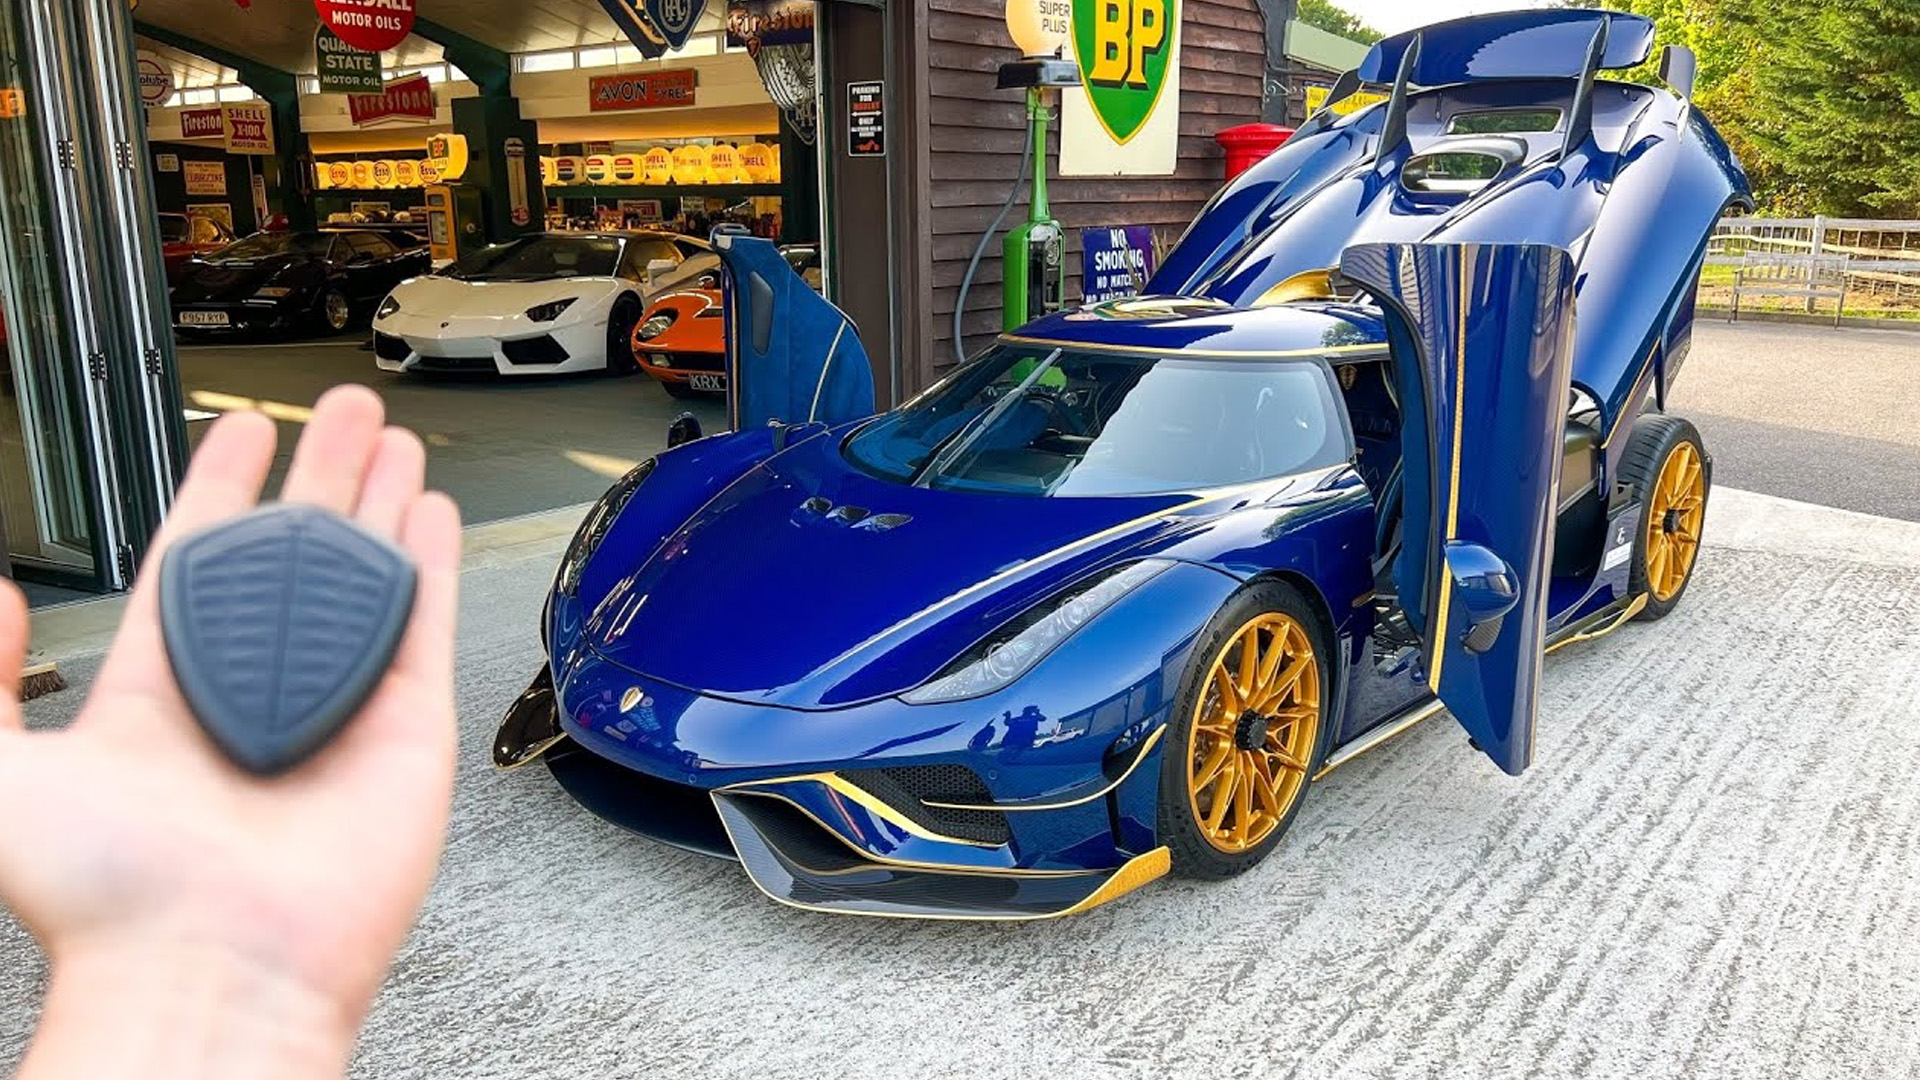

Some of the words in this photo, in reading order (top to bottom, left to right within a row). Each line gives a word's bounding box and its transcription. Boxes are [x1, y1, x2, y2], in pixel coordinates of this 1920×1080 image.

[1039, 1, 1070, 17] SUPER
[332, 10, 372, 28] MOTOR
[375, 16, 402, 30] OILS
[727, 7, 814, 33] Fireston
[1042, 18, 1067, 34] PLUS
[318, 36, 376, 55] QUA
[1089, 0, 1166, 91] BP
[326, 54, 373, 71] STATE
[323, 75, 360, 86] MOTOR
[363, 77, 380, 86] OIL
[598, 80, 647, 102] AVON
[354, 90, 430, 117] Firestone
[228, 108, 266, 120] SHELL
[182, 113, 221, 135] Fireston
[237, 124, 260, 137] X-100
[231, 141, 256, 149] MOTOR
[259, 141, 269, 149] OIL
[1110, 229, 1126, 249] NO
[1095, 249, 1144, 271] SMOKNG
[1097, 276, 1108, 290] NO
[691, 374, 720, 389] KRX
